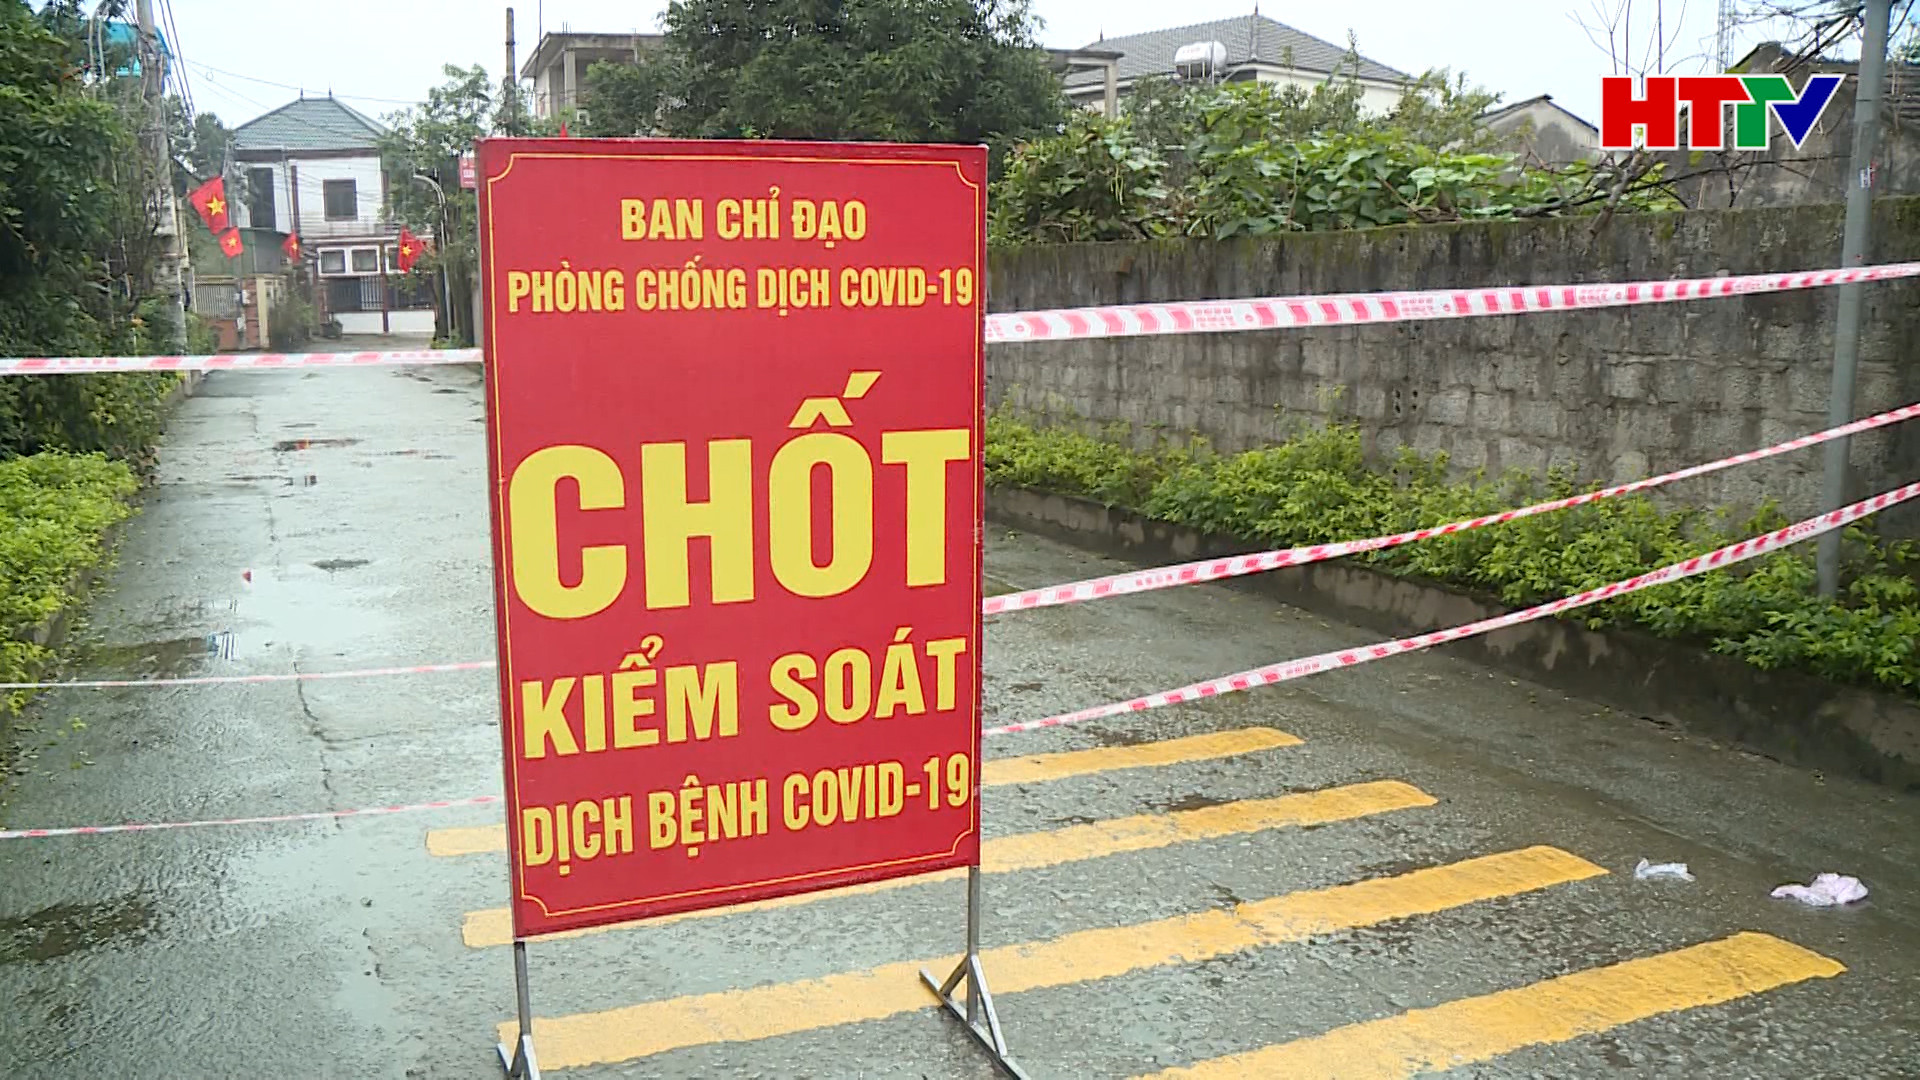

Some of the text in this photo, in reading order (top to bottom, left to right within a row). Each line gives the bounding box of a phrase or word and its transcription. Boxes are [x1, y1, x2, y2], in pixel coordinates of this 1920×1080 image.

[622, 186, 867, 248] BAN CHỈ ĐẠO
[508, 254, 974, 317] PHÒNG CHỐNG DỊCH COVID-19
[509, 371, 971, 619] CHỐT
[521, 627, 967, 759] KIỂM SOÁT
[522, 752, 970, 877] DỊCH BỆNH COVID-19
